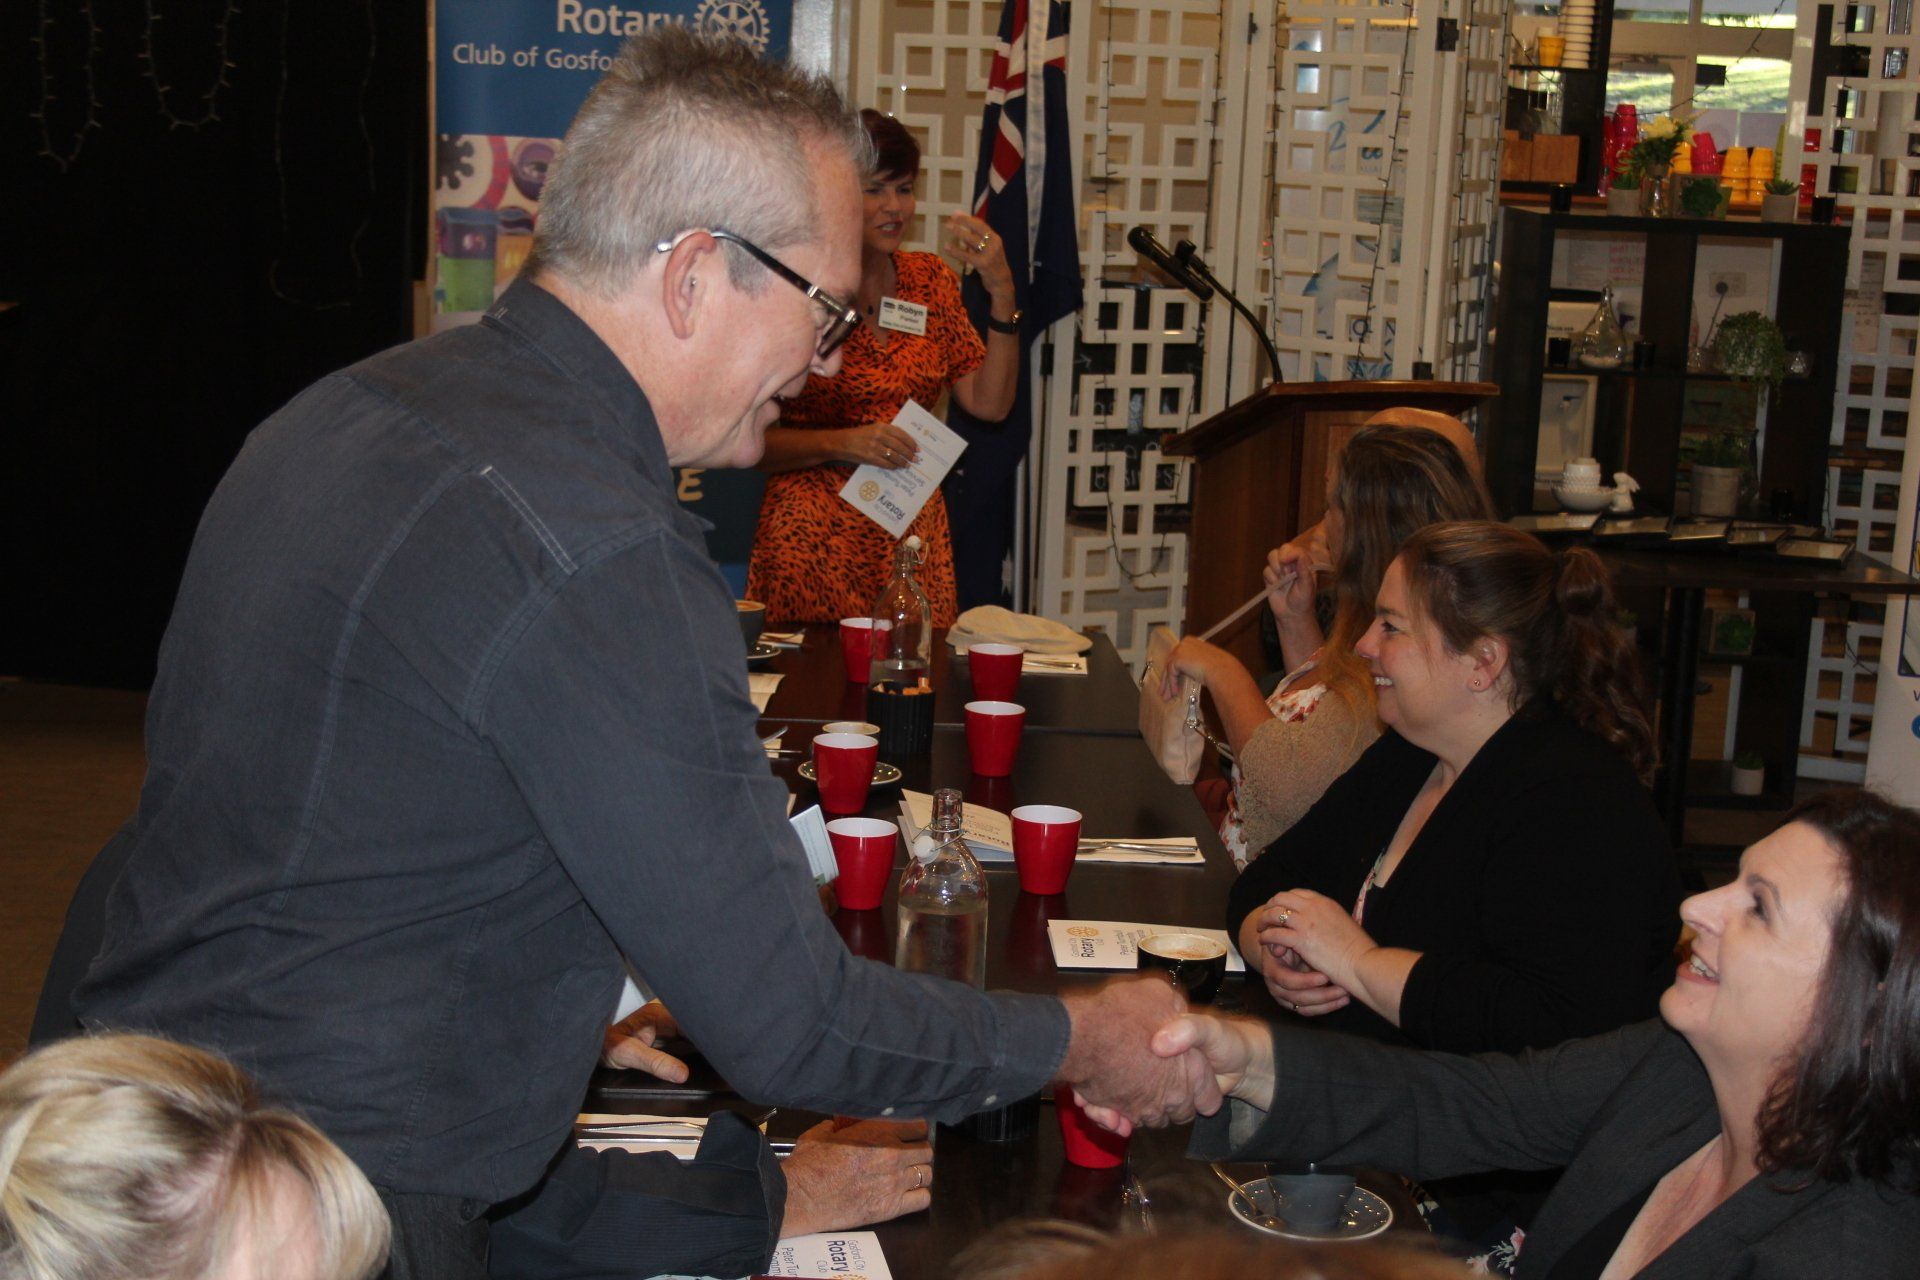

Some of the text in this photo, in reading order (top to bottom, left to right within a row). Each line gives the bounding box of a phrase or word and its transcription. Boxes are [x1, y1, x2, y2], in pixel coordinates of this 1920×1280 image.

[452, 43, 620, 72] Club of Gosfo
[897, 304, 925, 317] Robyn
[877, 495, 906, 521] Rotary
[1080, 937, 1096, 958] Rotary
[781, 1247, 795, 1265] Peter
[826, 1240, 850, 1272] Rotary
